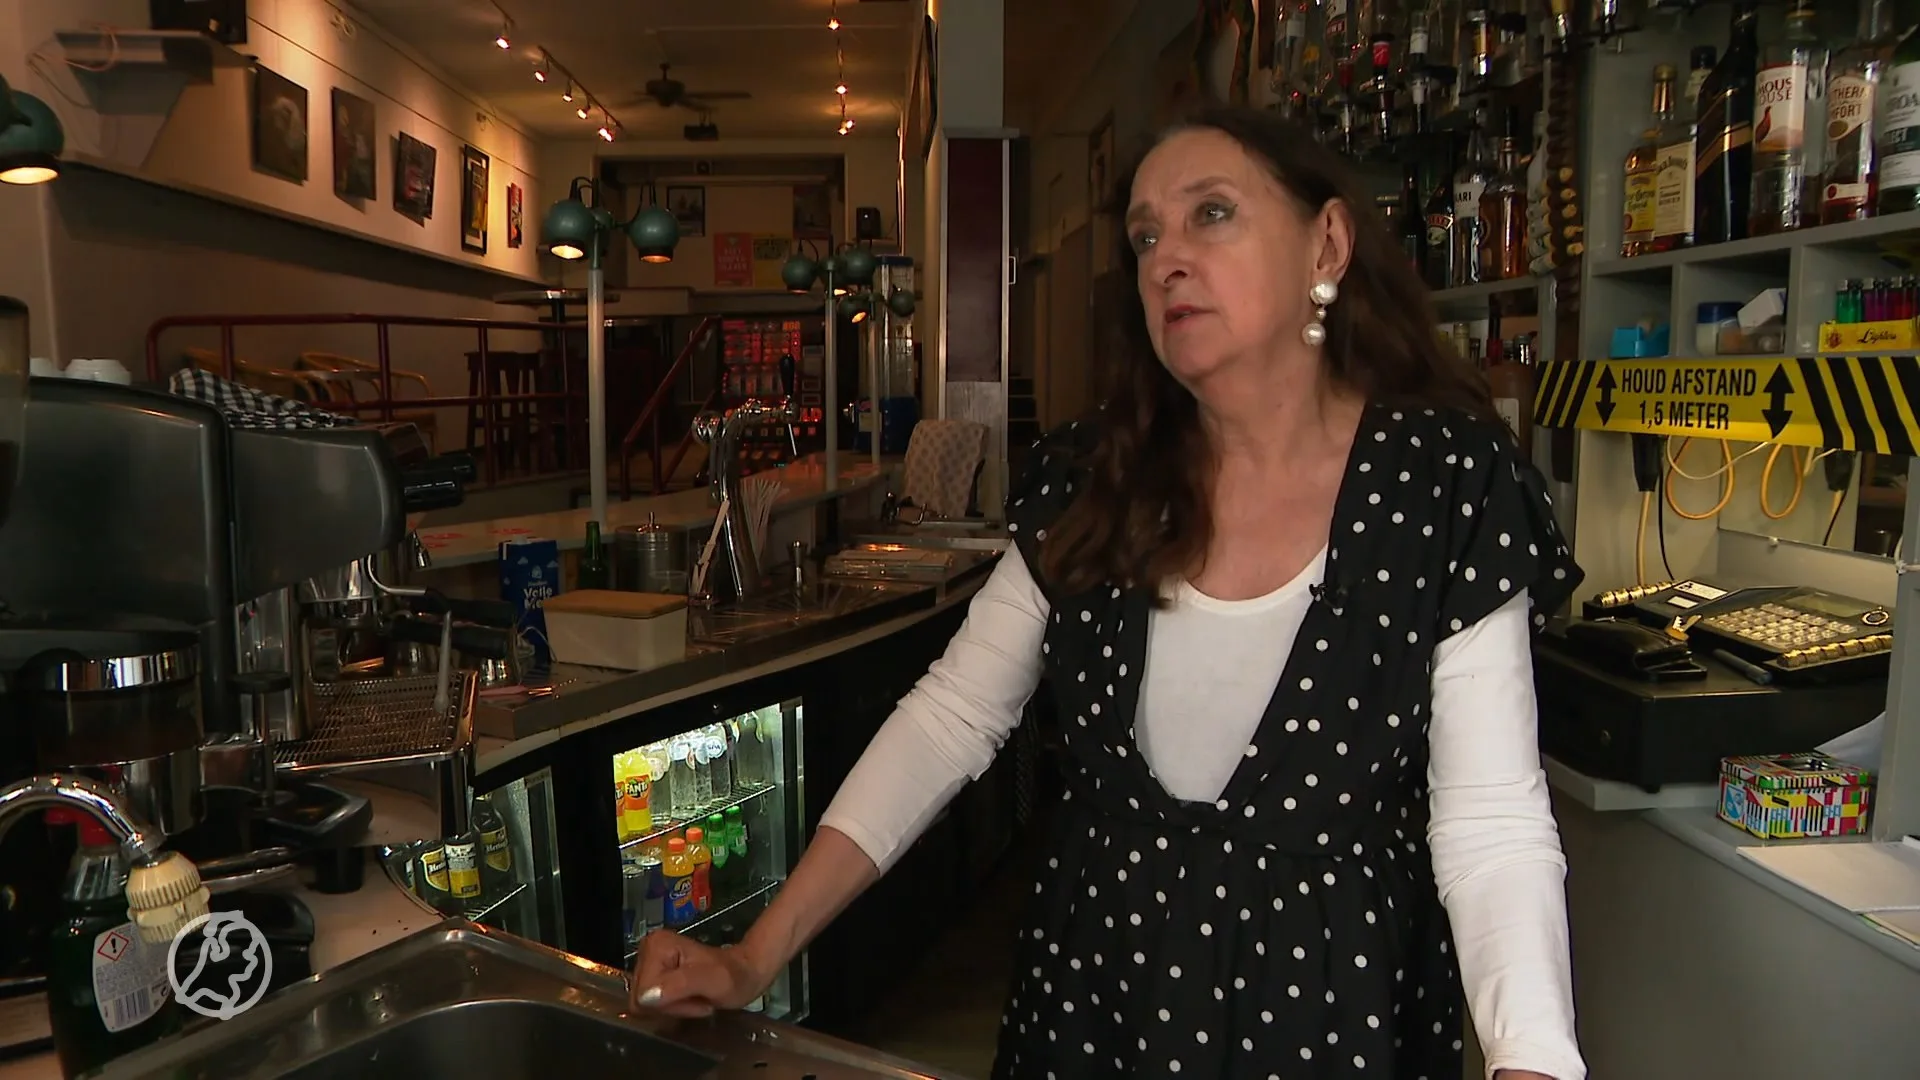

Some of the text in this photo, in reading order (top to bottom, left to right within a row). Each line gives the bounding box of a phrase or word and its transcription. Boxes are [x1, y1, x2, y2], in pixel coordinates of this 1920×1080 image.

[1621, 368, 1757, 397] HOUD AFSTAND
[1640, 400, 1730, 430] 1,5 METER
